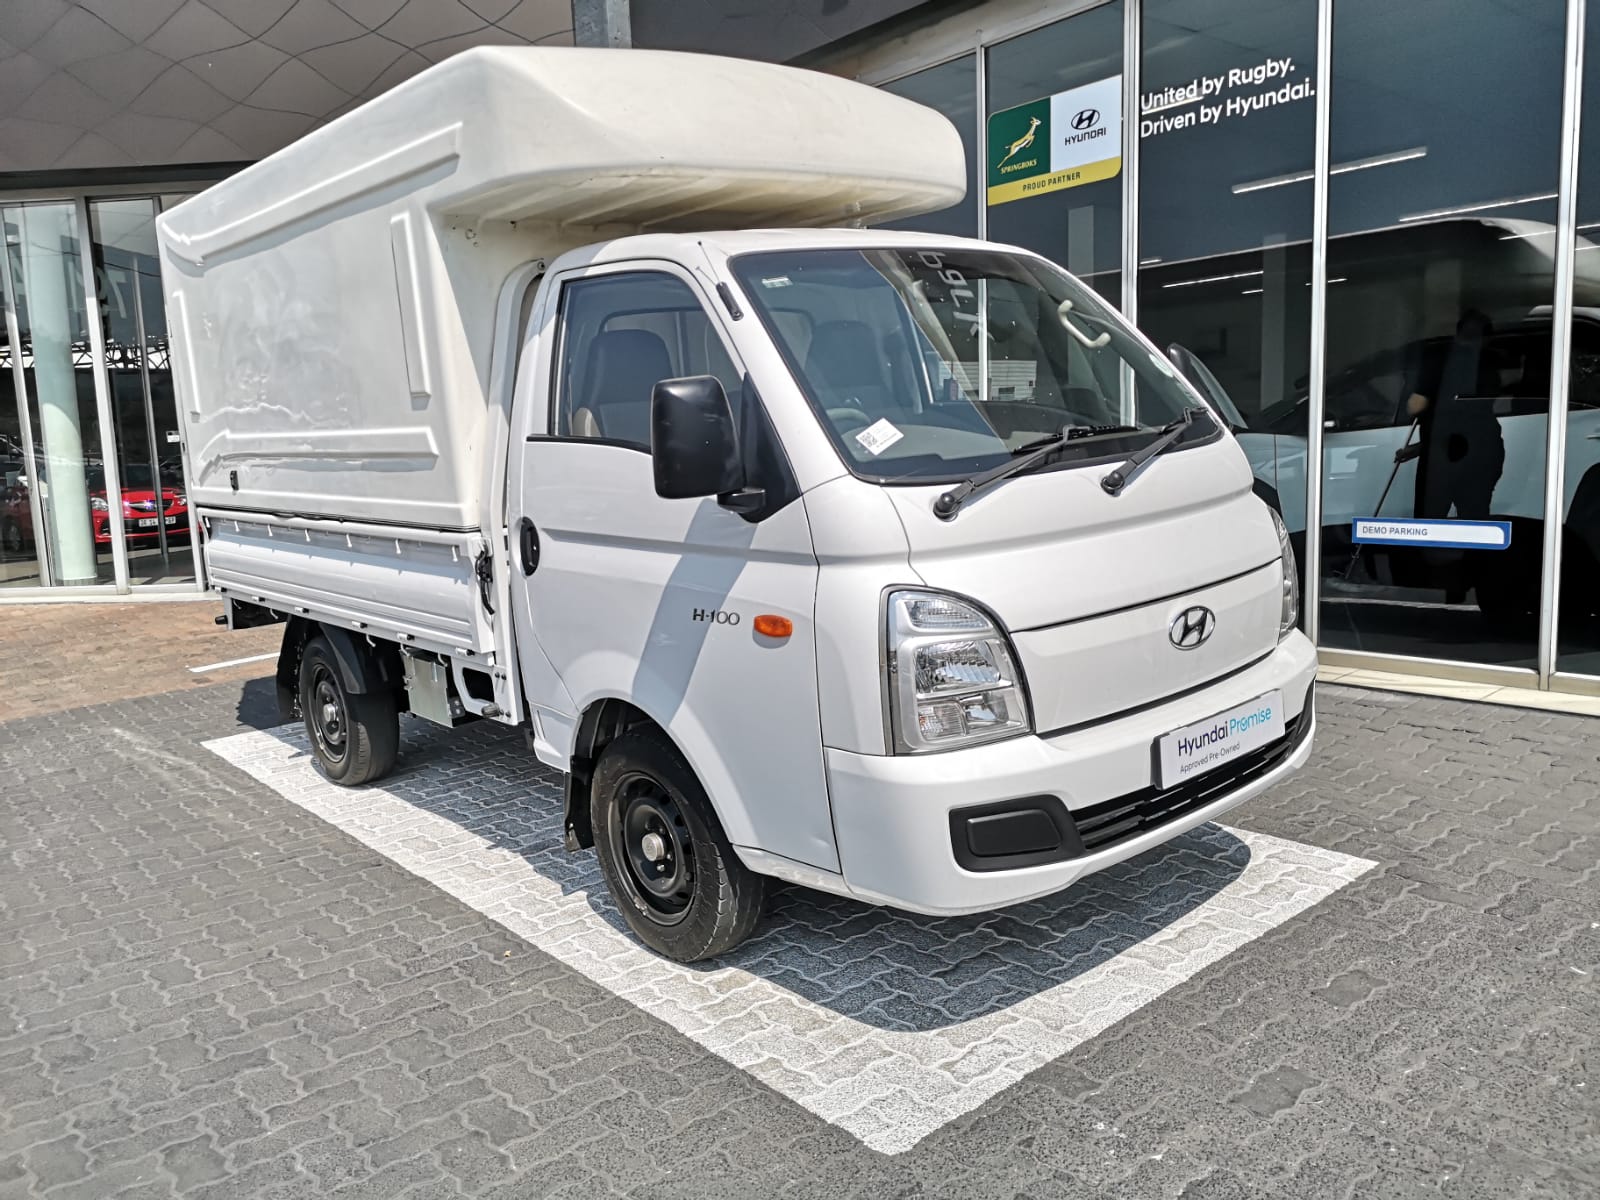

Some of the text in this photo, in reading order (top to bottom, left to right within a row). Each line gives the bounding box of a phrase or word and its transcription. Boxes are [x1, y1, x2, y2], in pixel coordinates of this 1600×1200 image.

[1140, 57, 1296, 111] United by Rugby.
[1140, 77, 1316, 138] Driven by Hyundai.
[1064, 127, 1107, 146] HYUNDAI
[1001, 159, 1037, 174] SPRINGBOKS
[1022, 171, 1081, 192] PROUD PARTNER
[1362, 525, 1428, 537] DEMO PARKING
[692, 608, 740, 625] H-100
[1178, 707, 1271, 756] Hyundai Promise
[1180, 743, 1240, 774] Approved Pre-Owned
